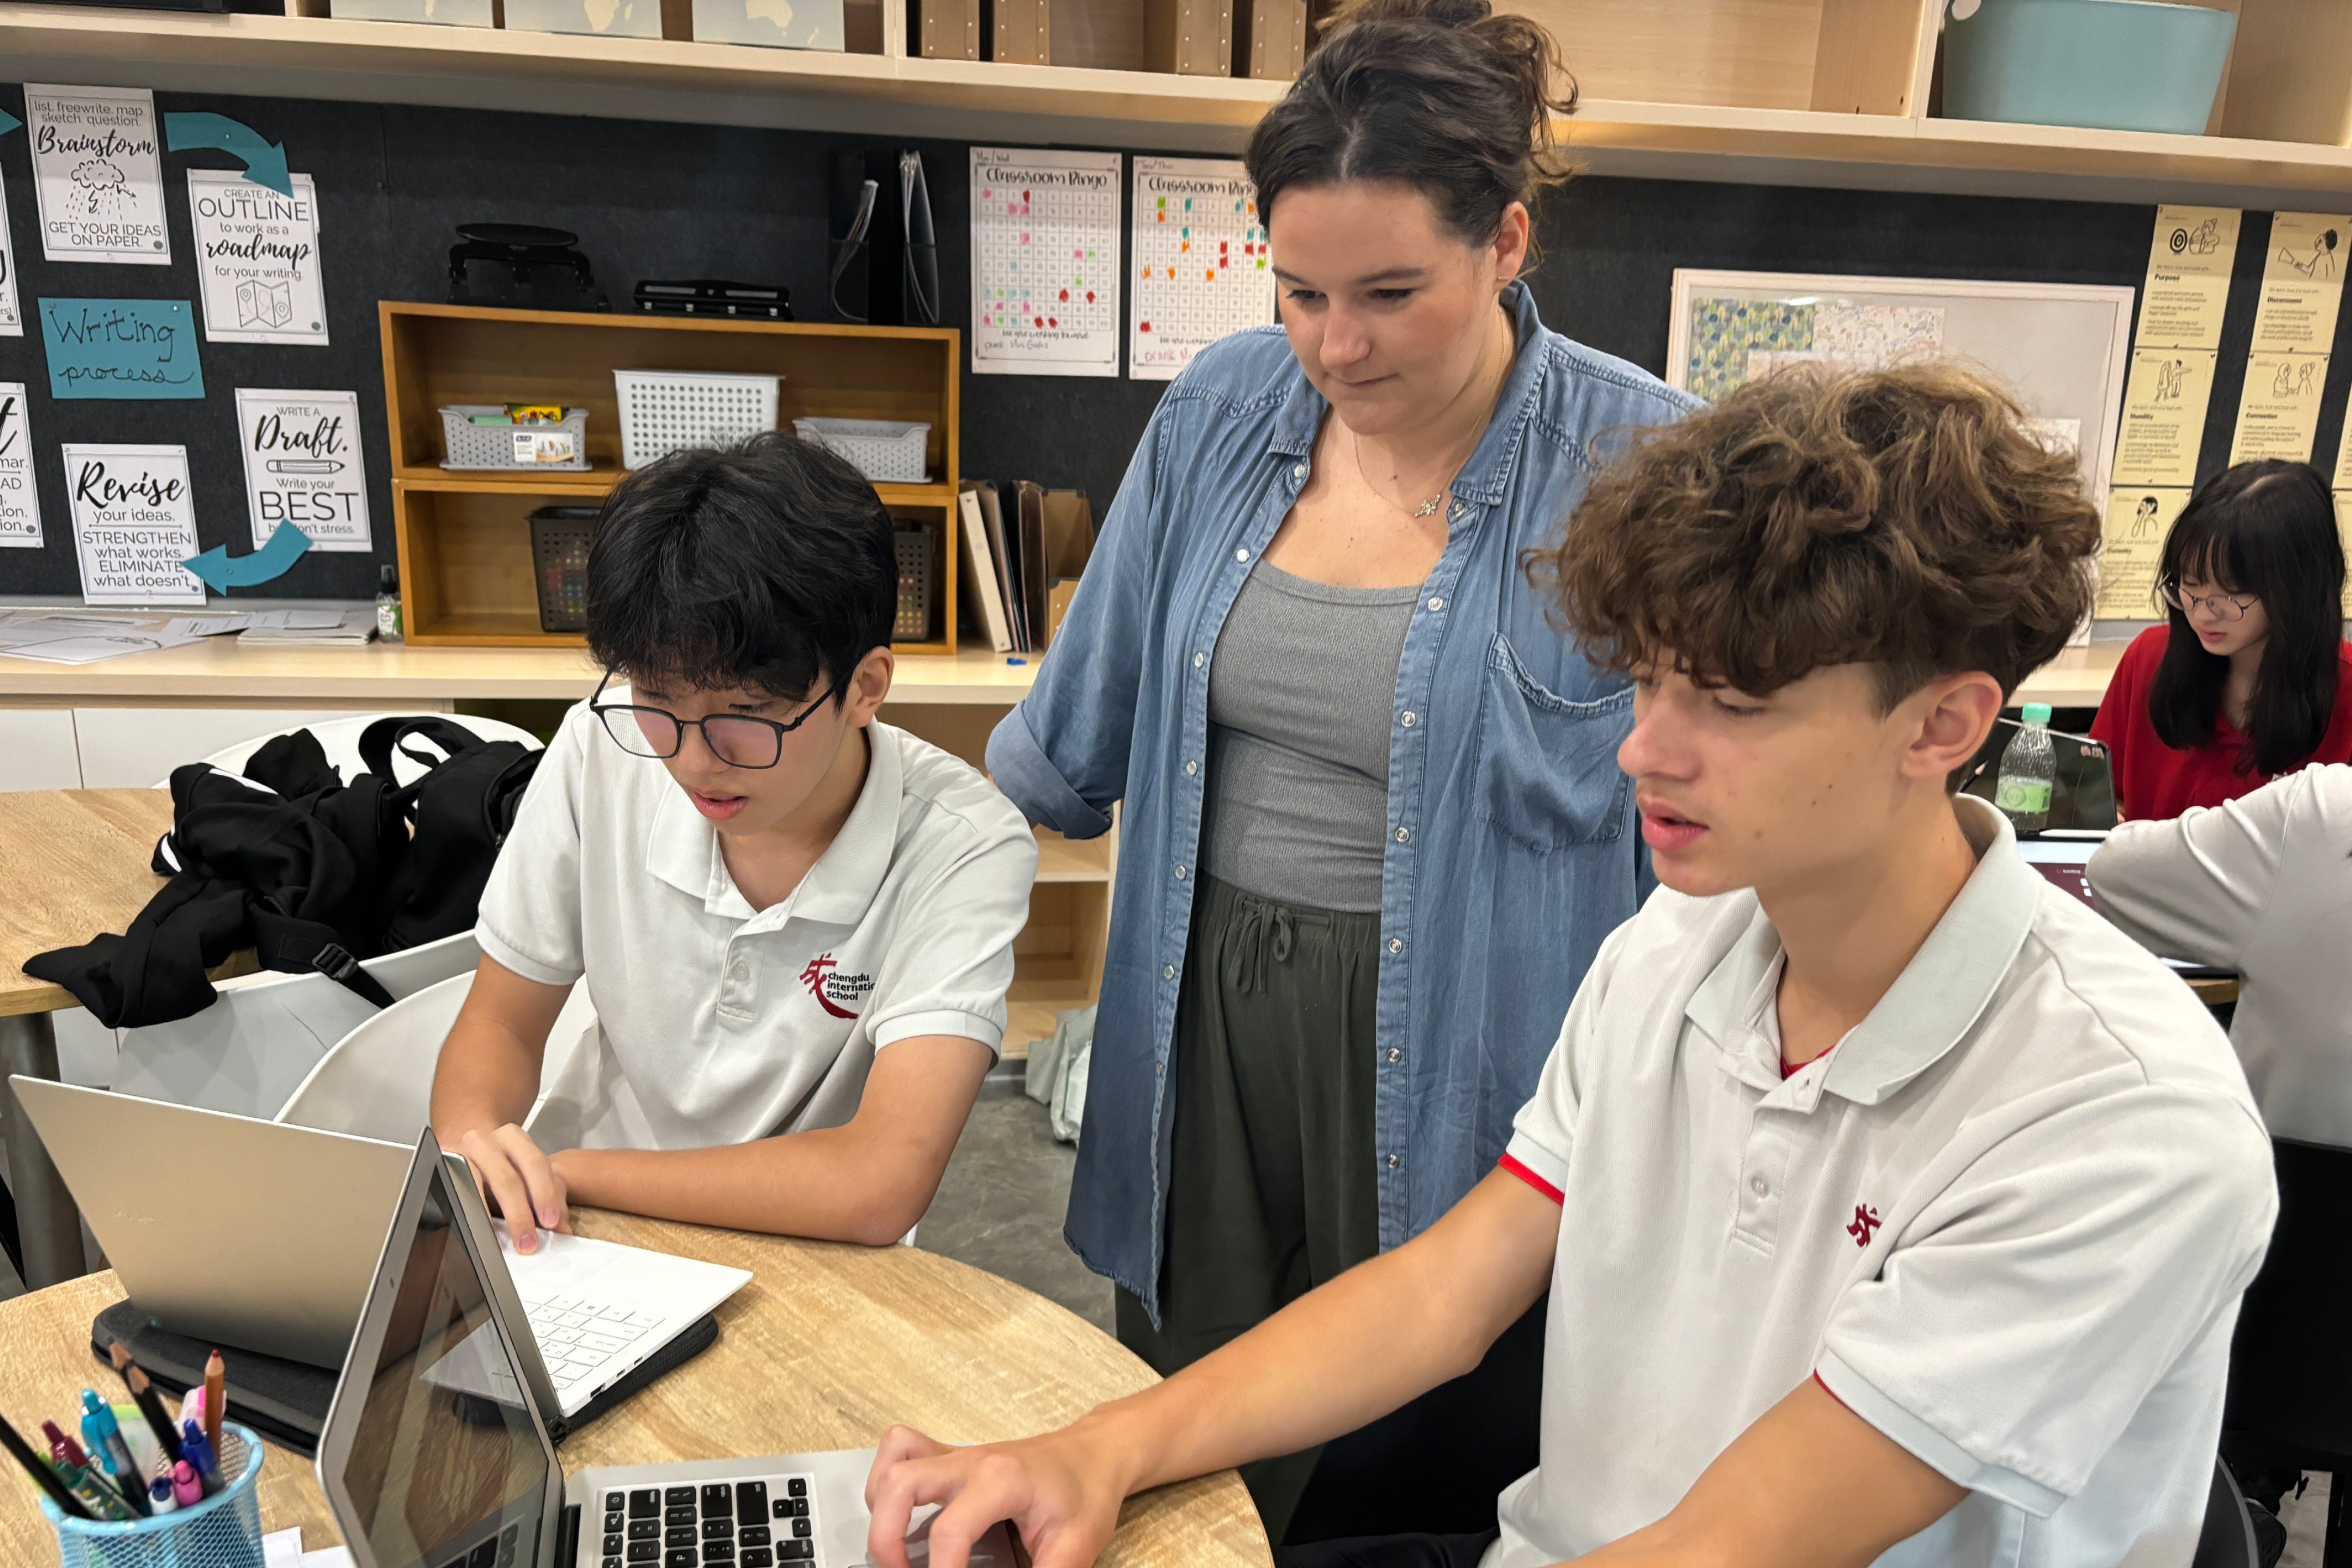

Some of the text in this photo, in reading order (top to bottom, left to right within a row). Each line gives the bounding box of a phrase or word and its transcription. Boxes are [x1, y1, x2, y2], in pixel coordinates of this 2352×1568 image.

[57, 101, 113, 115] freewrite.
[117, 106, 145, 119] map.
[87, 114, 141, 127] question.
[38, 125, 155, 158] Brainstorm
[986, 167, 1108, 191] Classroom Bingo
[1149, 177, 1226, 194] Classroom
[224, 188, 280, 200] CREATE AN
[198, 197, 309, 222] OUTLINE
[48, 221, 162, 237] GET YOUR IDEAS
[220, 222, 289, 235] to work as a
[71, 234, 143, 247] ON PAPER.
[206, 233, 312, 271] roadmap
[215, 265, 230, 276] for
[233, 267, 260, 279] your
[49, 307, 175, 363] Writing
[58, 366, 194, 388] process
[276, 406, 321, 417] WRITE A
[254, 413, 348, 459] Draft.
[77, 461, 185, 509] Revise
[276, 478, 335, 490] Write your
[259, 491, 359, 522] BEST
[93, 508, 175, 524] your ideas.
[295, 522, 319, 534] on't
[83, 531, 192, 545] STRENGTHEN
[95, 545, 184, 559] what works.
[99, 559, 184, 573] ELIMINATE
[93, 573, 132, 587] what
[828, 971, 870, 985] chengdu
[826, 990, 859, 1001] school
